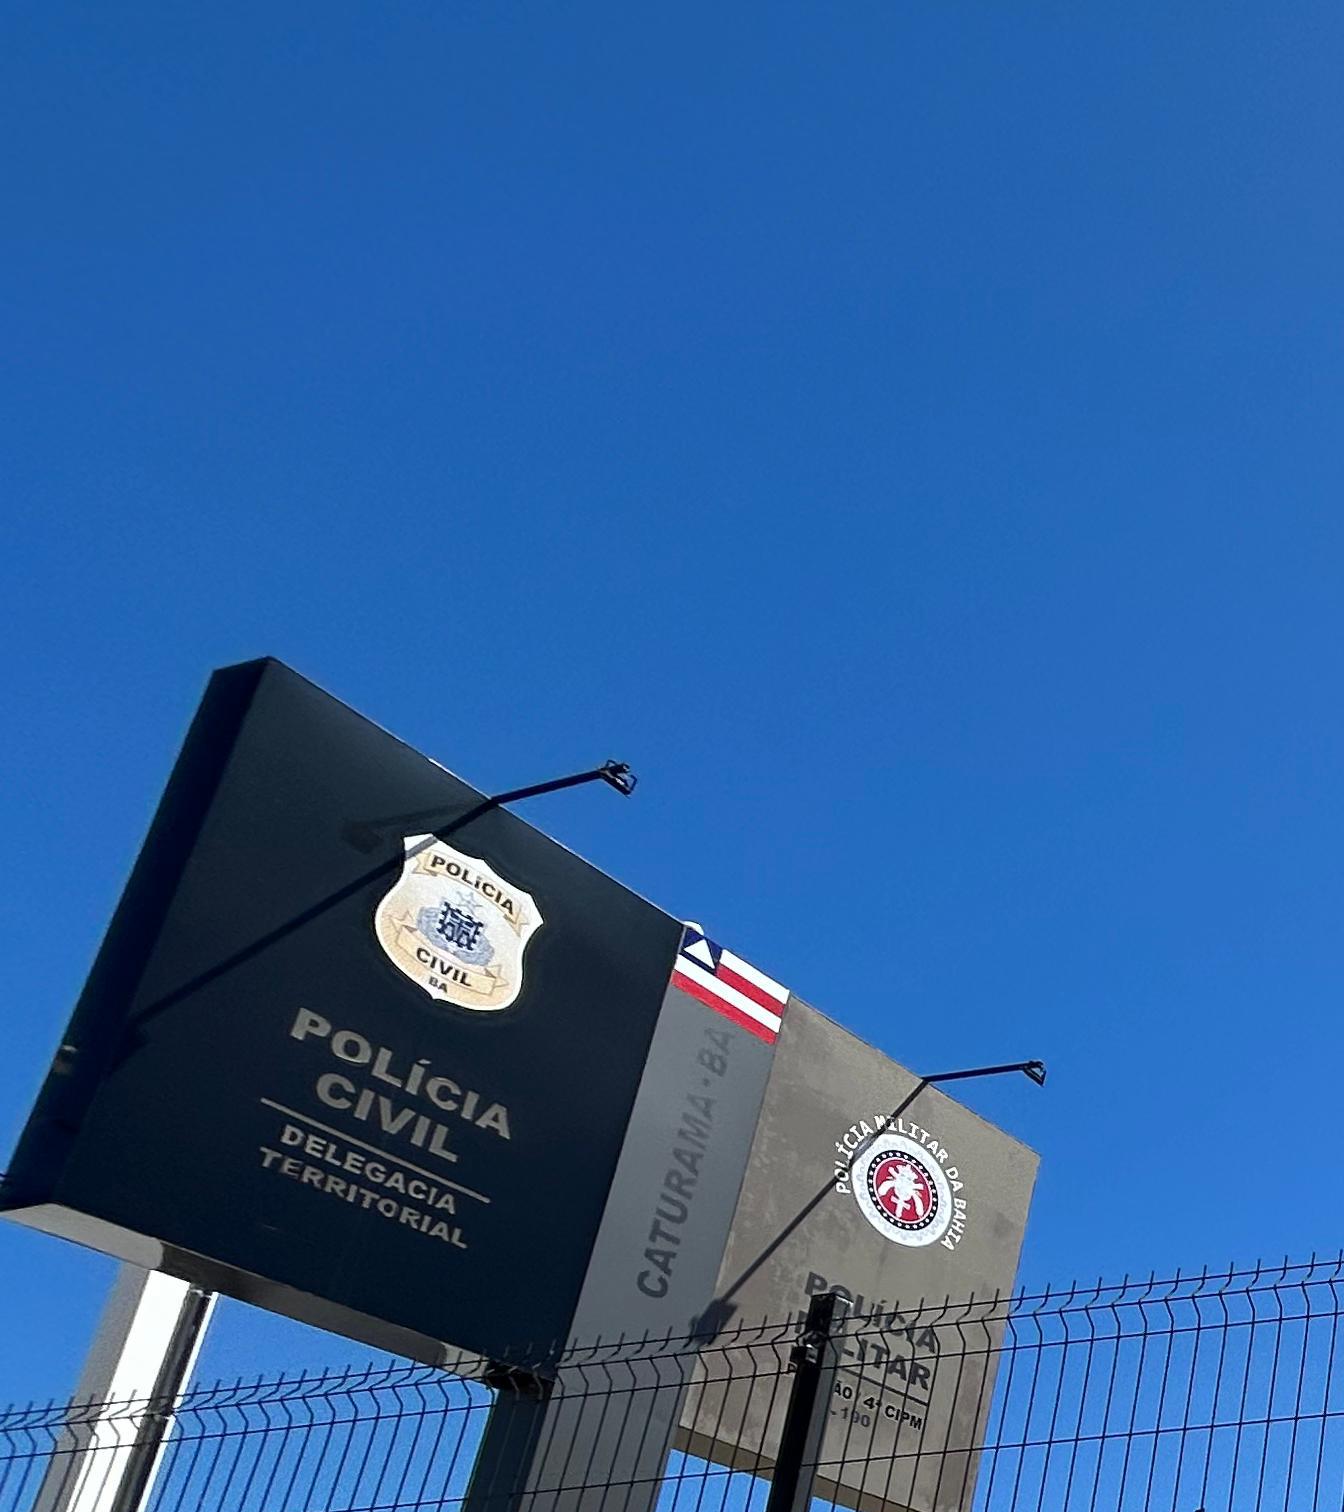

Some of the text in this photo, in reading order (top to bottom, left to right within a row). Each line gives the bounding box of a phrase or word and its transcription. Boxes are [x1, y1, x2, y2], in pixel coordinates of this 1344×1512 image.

[416, 947, 472, 987] CIVIL
[428, 976, 448, 993] BA
[289, 1007, 512, 1141] POLÍCIA
[316, 1073, 459, 1163] CIVIL
[874, 1115, 950, 1164] MILITAR
[280, 1124, 457, 1215] DELEGACIA
[636, 1092, 716, 1298] CATURAMA
[697, 1027, 736, 1078] BA
[945, 1166, 964, 1192] DA
[259, 1147, 468, 1250] TERRITORIAL
[940, 1197, 967, 1251] BAHIA
[795, 1310, 931, 1391] ITAR
[884, 1405, 923, 1431] CIPM
